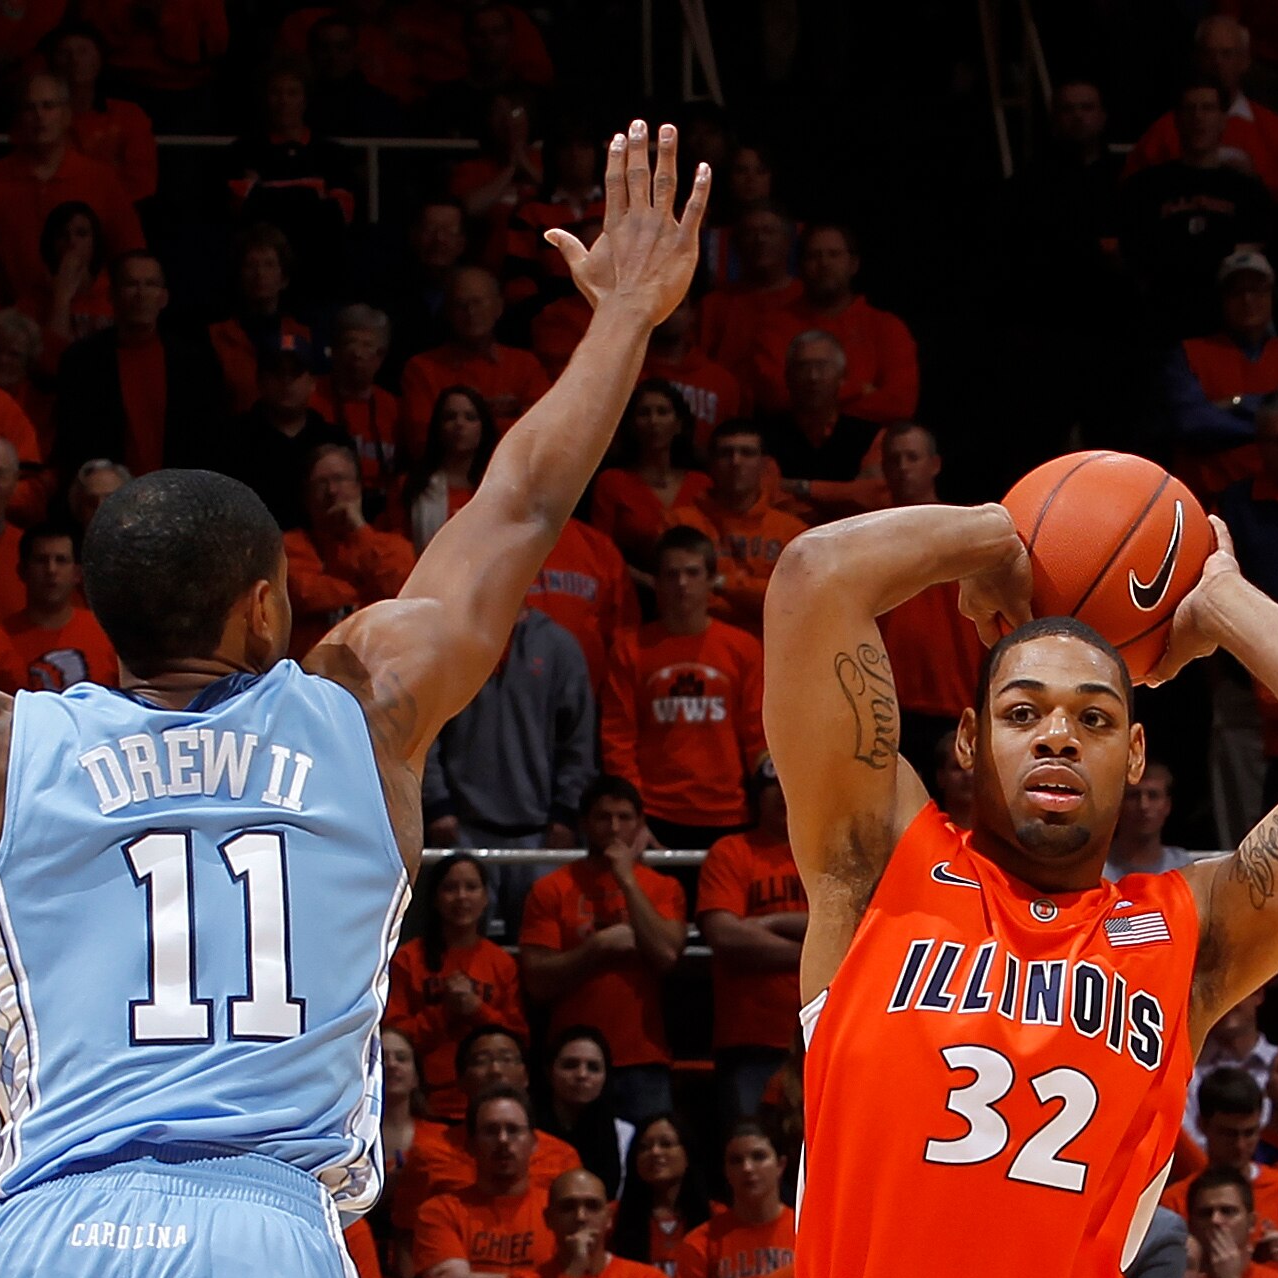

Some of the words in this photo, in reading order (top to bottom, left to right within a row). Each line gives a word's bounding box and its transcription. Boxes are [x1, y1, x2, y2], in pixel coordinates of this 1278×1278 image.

[78, 728, 259, 817] DREW
[260, 743, 314, 812] II
[121, 826, 306, 1047] 11
[886, 938, 1165, 1072] ILLINOIS
[924, 1044, 1101, 1193] 32
[70, 1221, 188, 1250] CAROLINA
[472, 1231, 534, 1260] CHIEF
